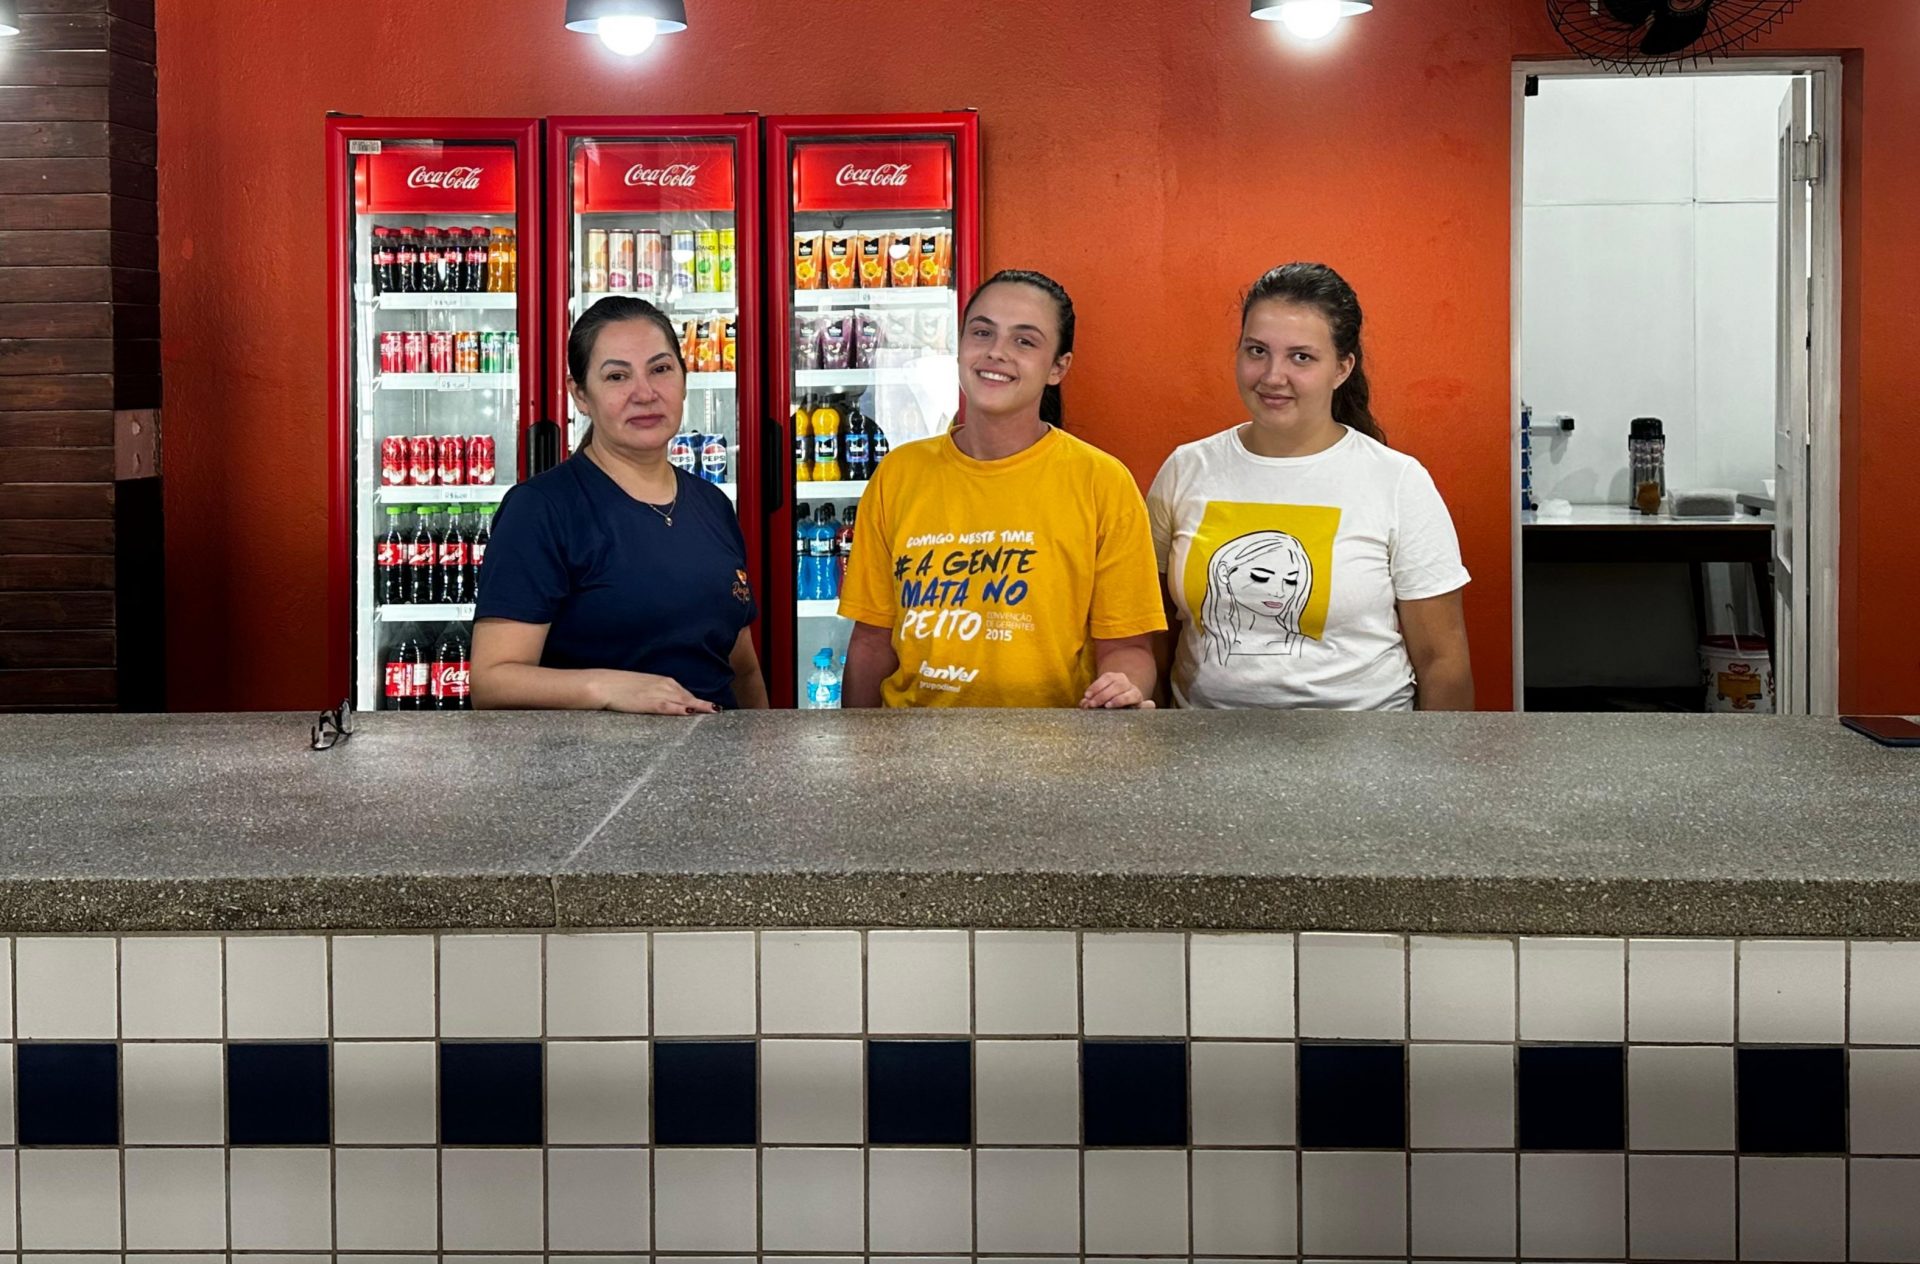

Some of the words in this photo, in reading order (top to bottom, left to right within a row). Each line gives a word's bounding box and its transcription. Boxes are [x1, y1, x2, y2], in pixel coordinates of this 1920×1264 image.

[407, 165, 484, 190] Coca-Cola
[624, 163, 700, 187] Coca-Cola
[835, 163, 912, 187] Coca-Cola
[906, 533, 955, 548] COMIGO
[958, 530, 996, 545] NESTE
[943, 545, 1038, 576] GENTE
[901, 576, 970, 608] MATA
[982, 574, 1028, 606] NO
[900, 608, 982, 641] PEITO
[985, 628, 1013, 641] 2015
